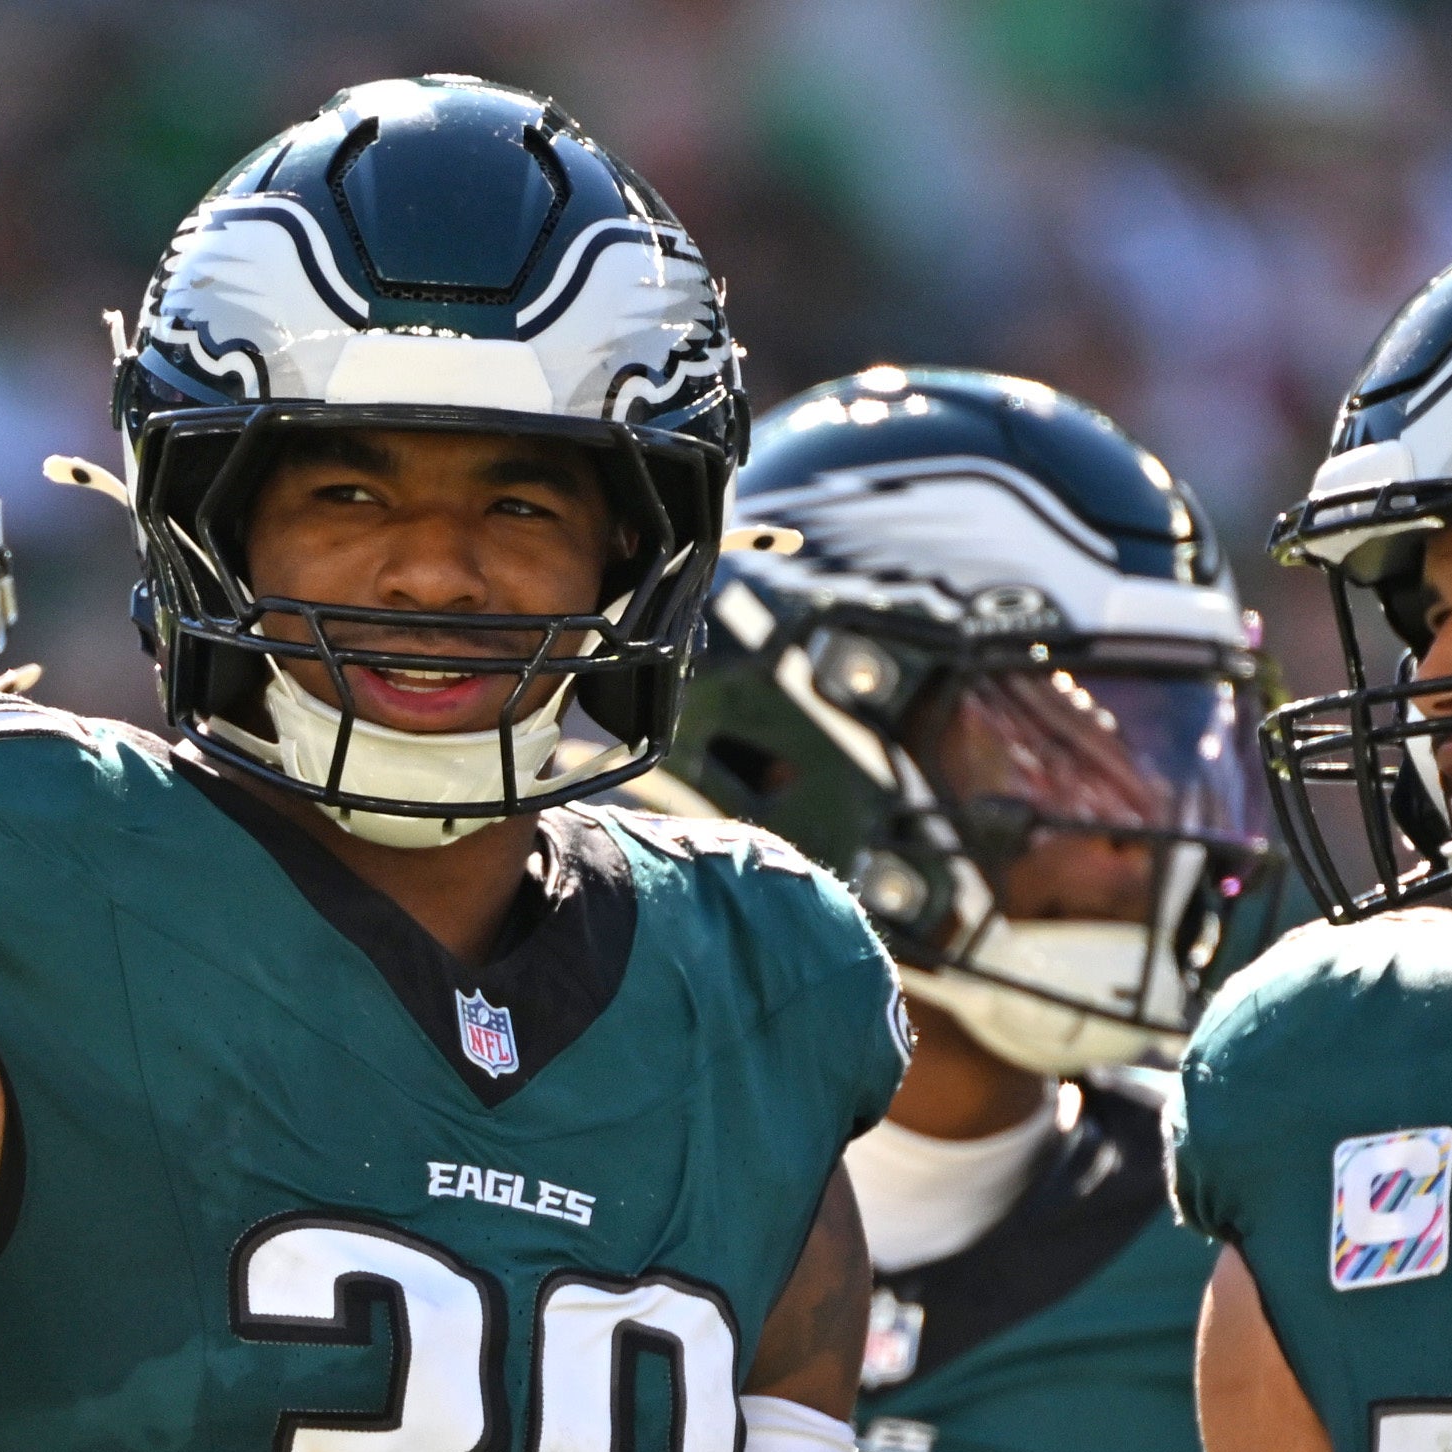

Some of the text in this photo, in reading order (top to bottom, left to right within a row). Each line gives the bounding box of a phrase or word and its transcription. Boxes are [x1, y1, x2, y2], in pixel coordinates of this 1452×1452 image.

[467, 1023, 511, 1063] NFL
[426, 1160, 597, 1227] EAGLES
[1346, 1139, 1446, 1244] C
